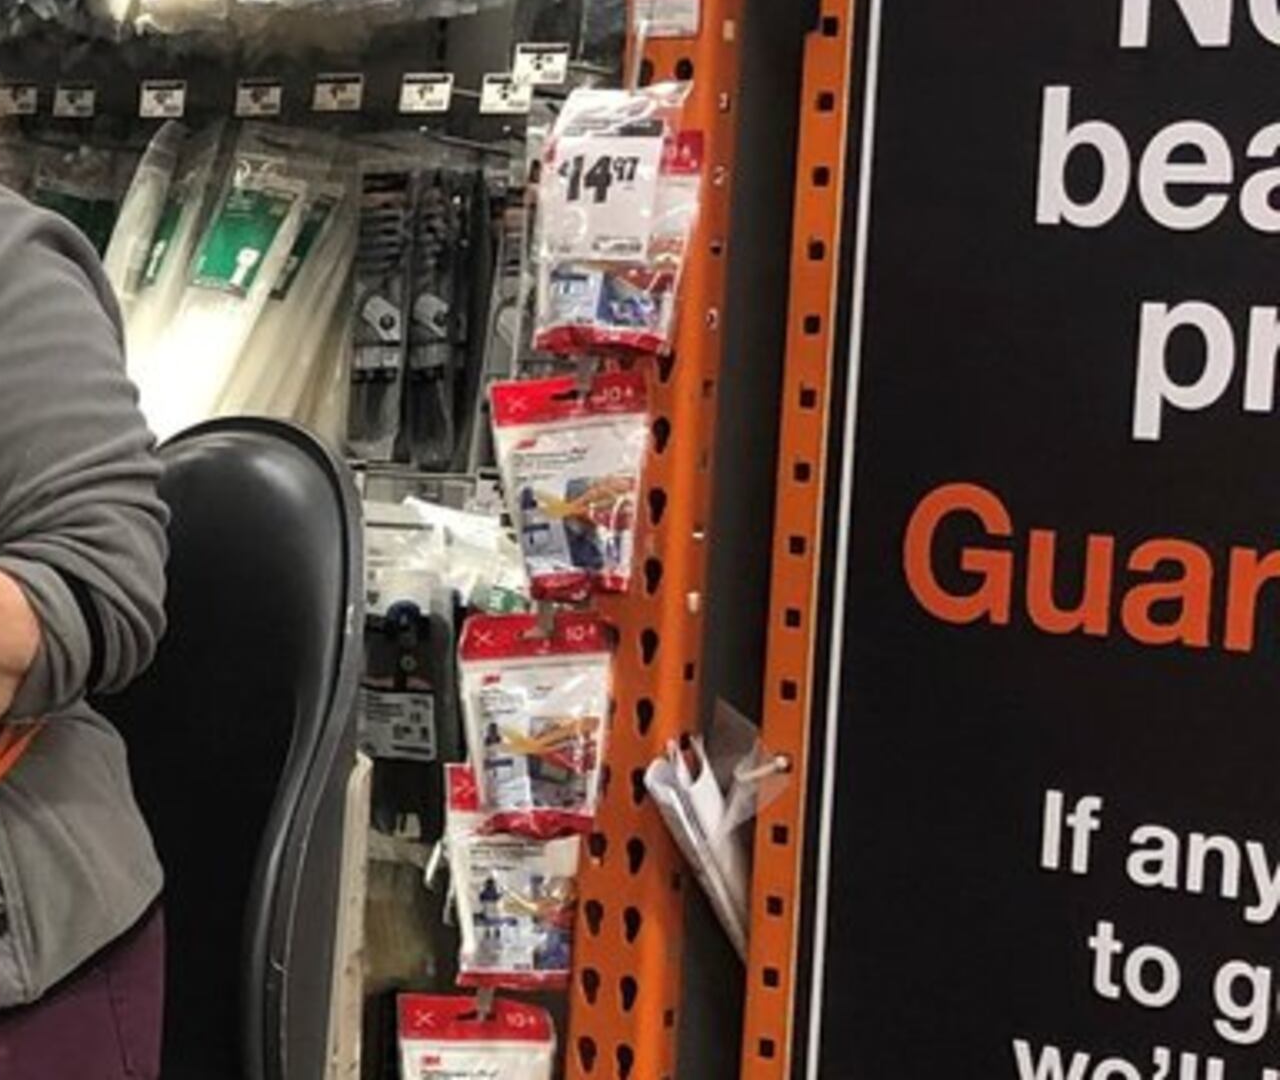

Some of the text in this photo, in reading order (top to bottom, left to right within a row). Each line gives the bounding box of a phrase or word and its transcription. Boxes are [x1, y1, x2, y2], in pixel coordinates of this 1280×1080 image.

[902, 482, 1280, 652] Guar
[1040, 789, 1103, 875] If
[1088, 921, 1280, 1045] to g
